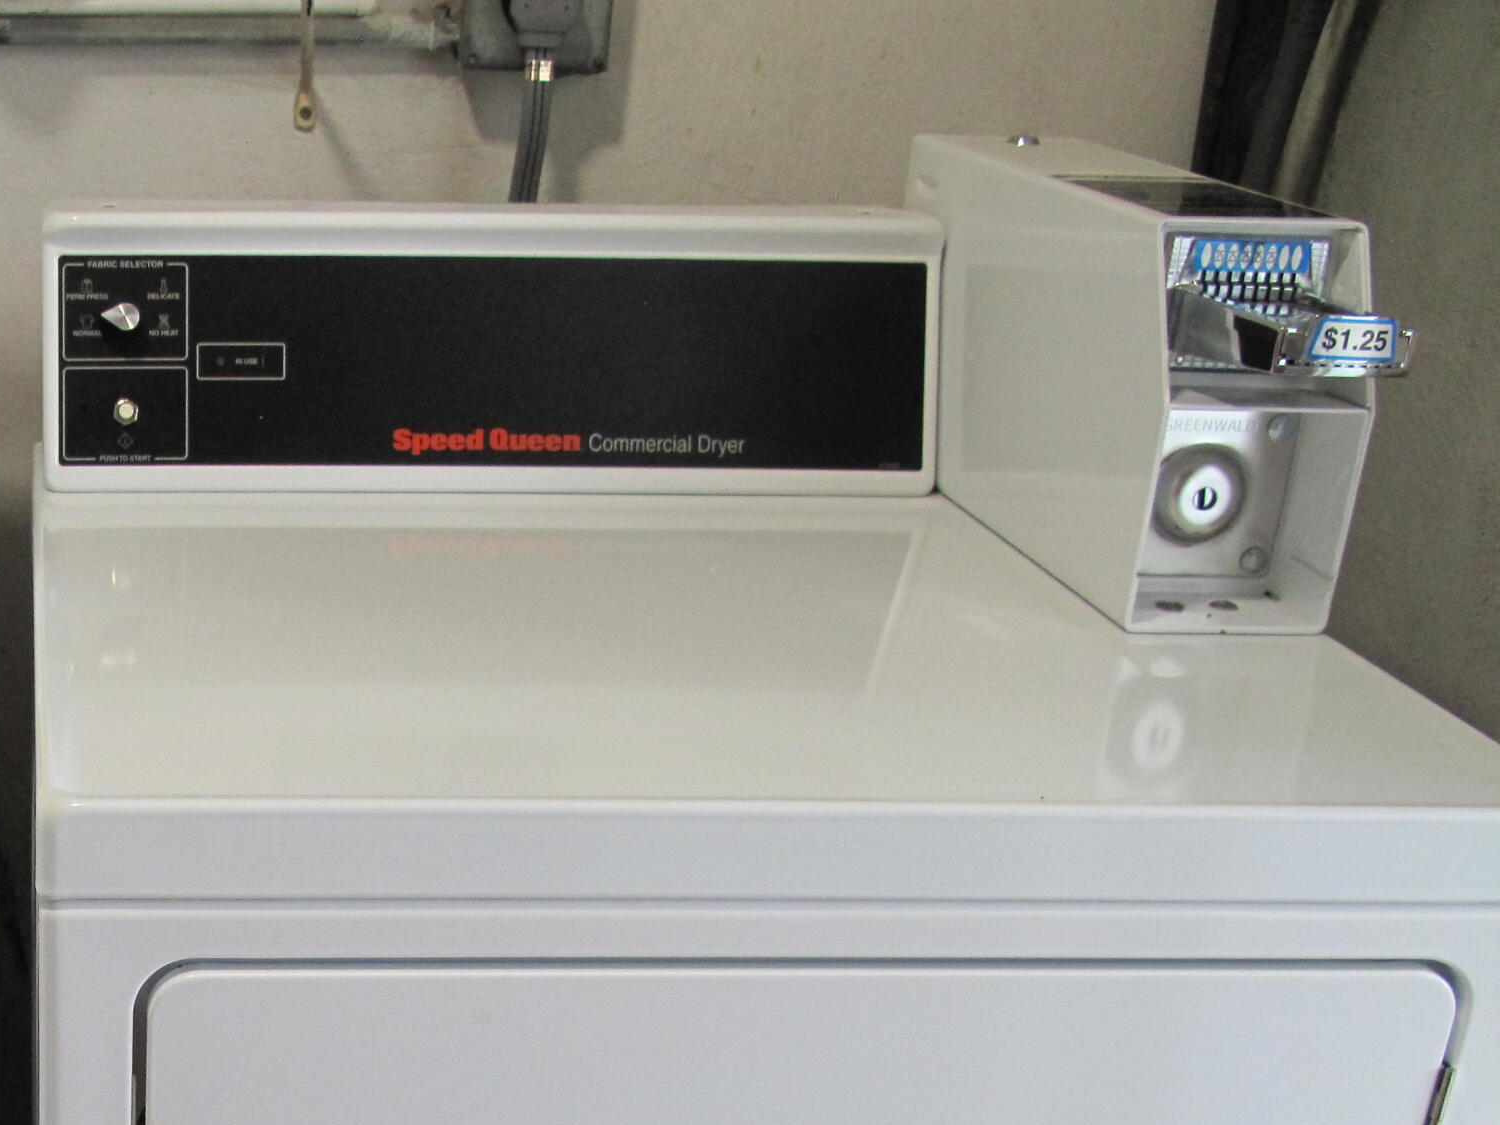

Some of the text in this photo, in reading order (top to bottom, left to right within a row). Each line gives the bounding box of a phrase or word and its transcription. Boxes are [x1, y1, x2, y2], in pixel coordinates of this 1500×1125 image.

[87, 260, 164, 269] FABRIC SELECTOR
[160, 329, 179, 337] HEAT
[1321, 329, 1389, 352] $1.25
[392, 428, 745, 458] Speed Queen Commercial Dryer
